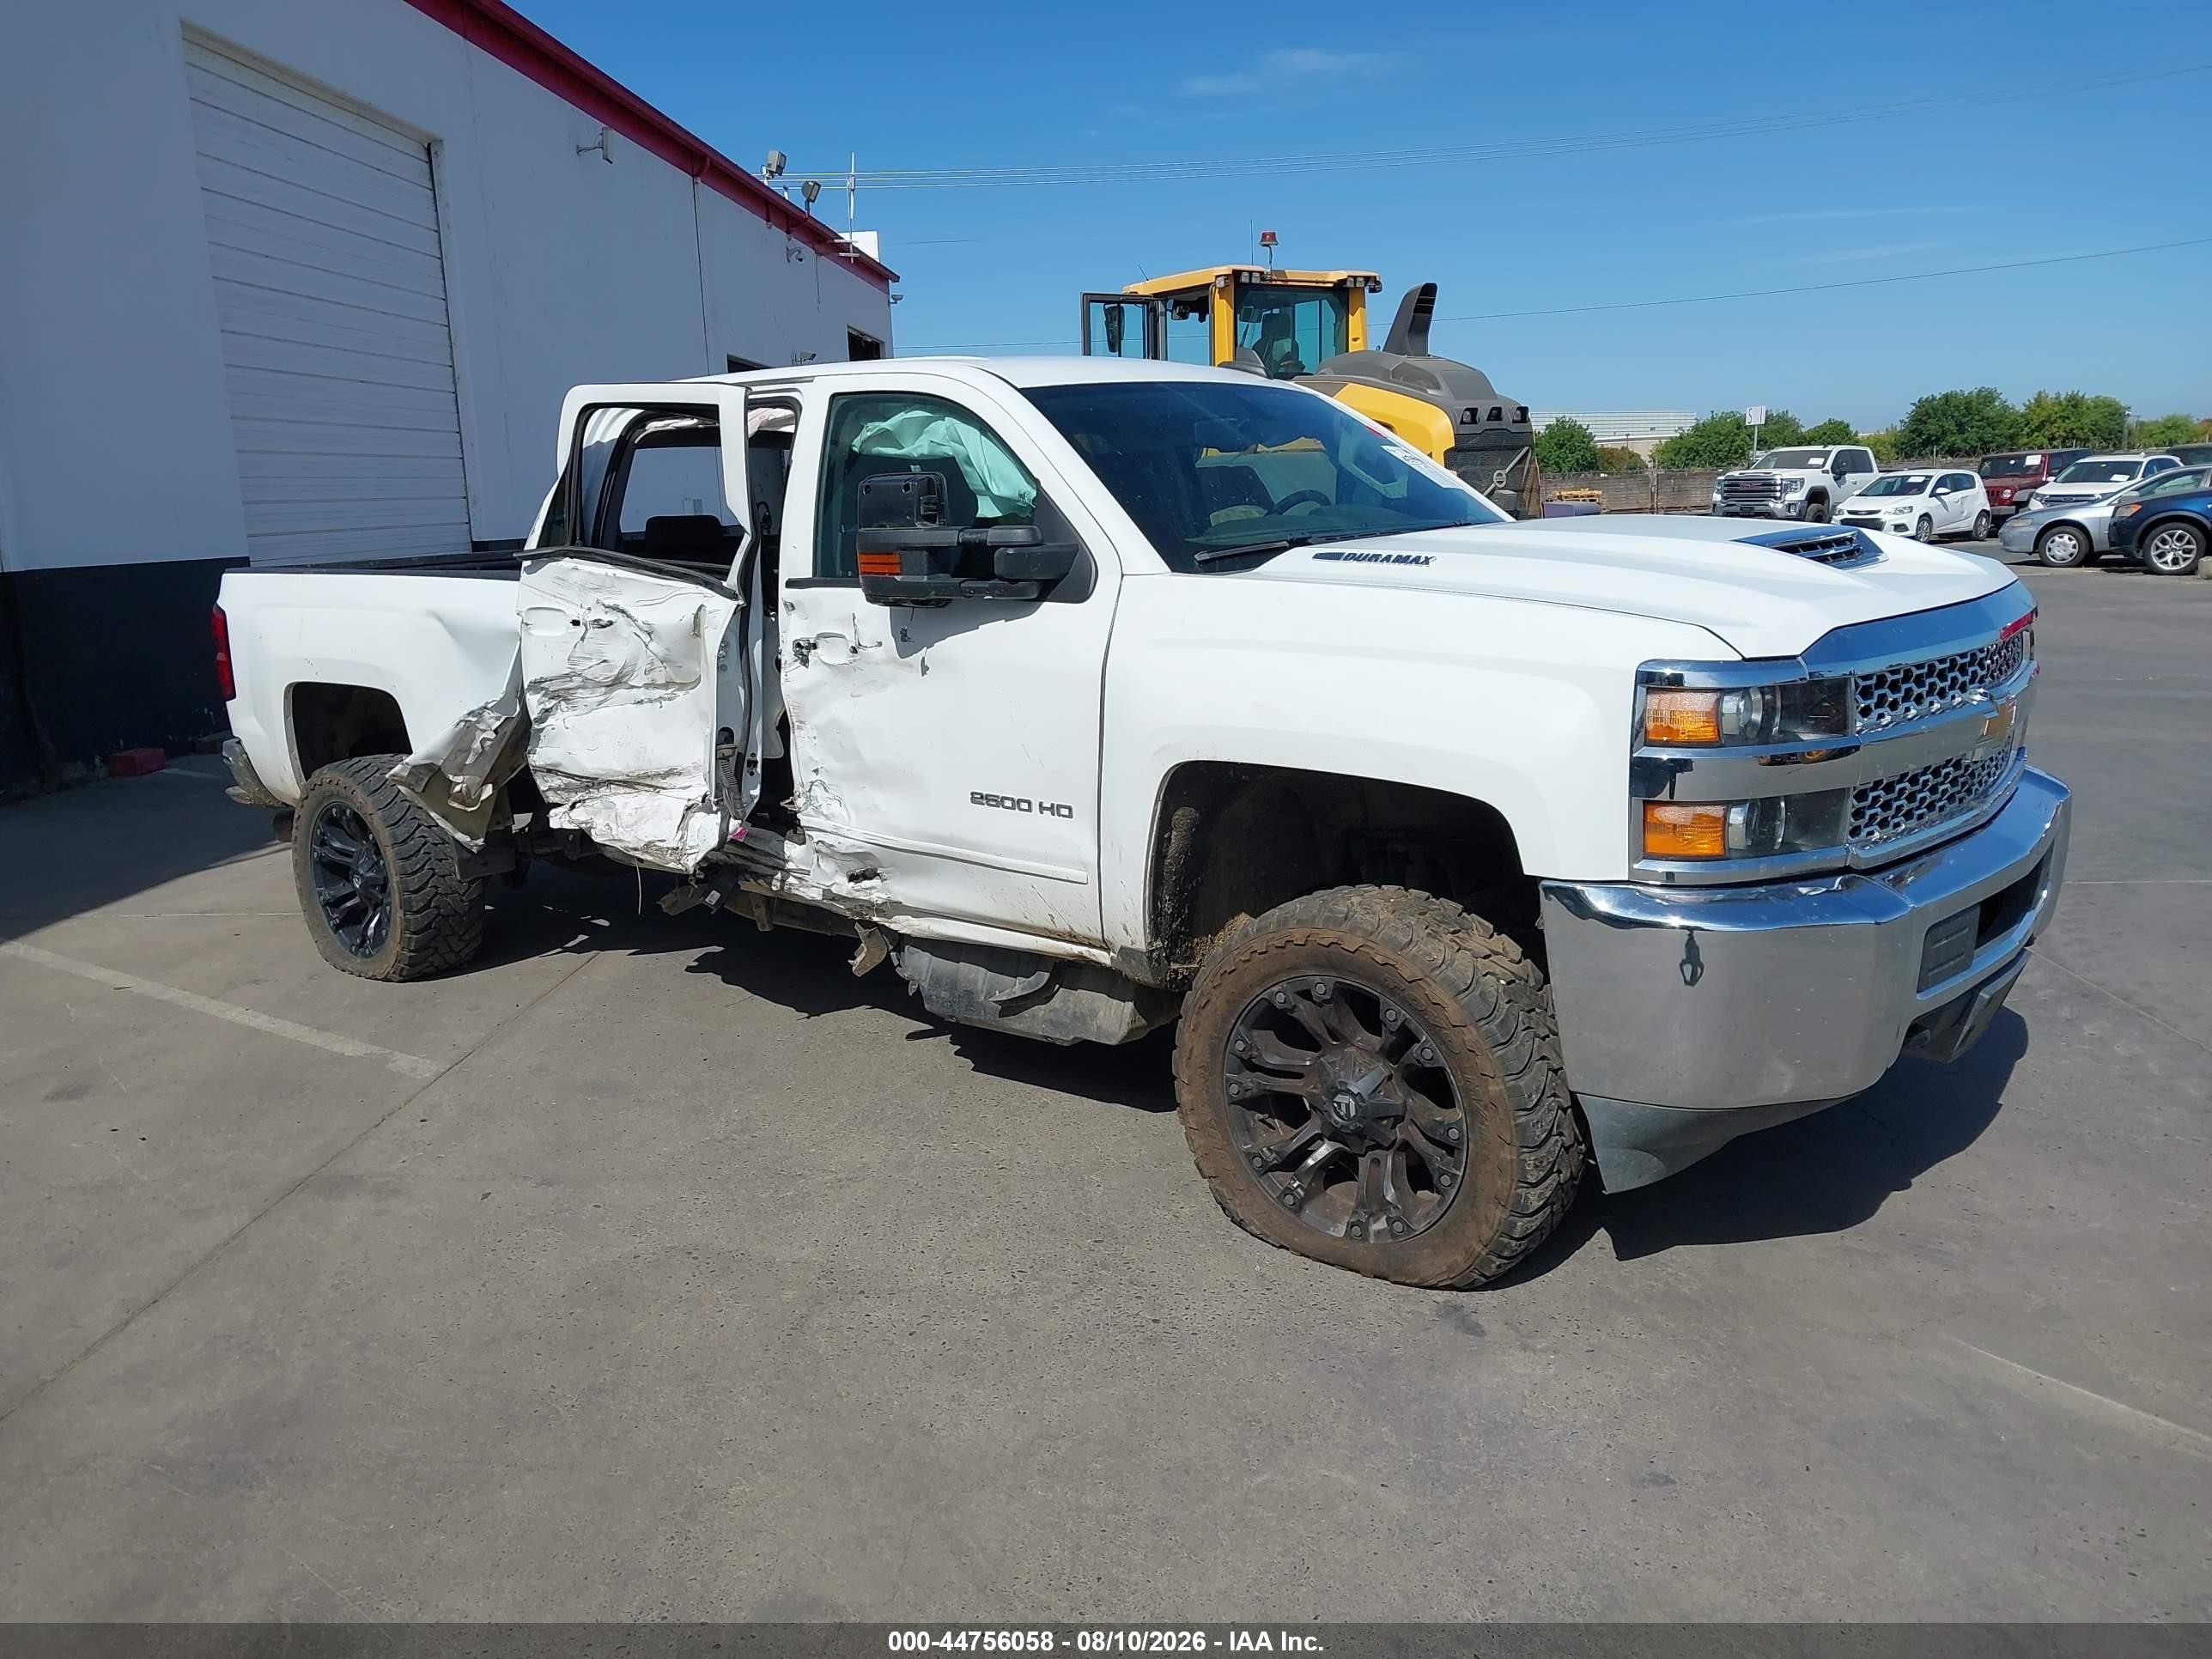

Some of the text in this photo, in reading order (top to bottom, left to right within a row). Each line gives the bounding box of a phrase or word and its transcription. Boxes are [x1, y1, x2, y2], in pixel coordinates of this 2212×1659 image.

[1342, 552, 1437, 567] DURAMAX
[969, 791, 1073, 819] 2500 HD
